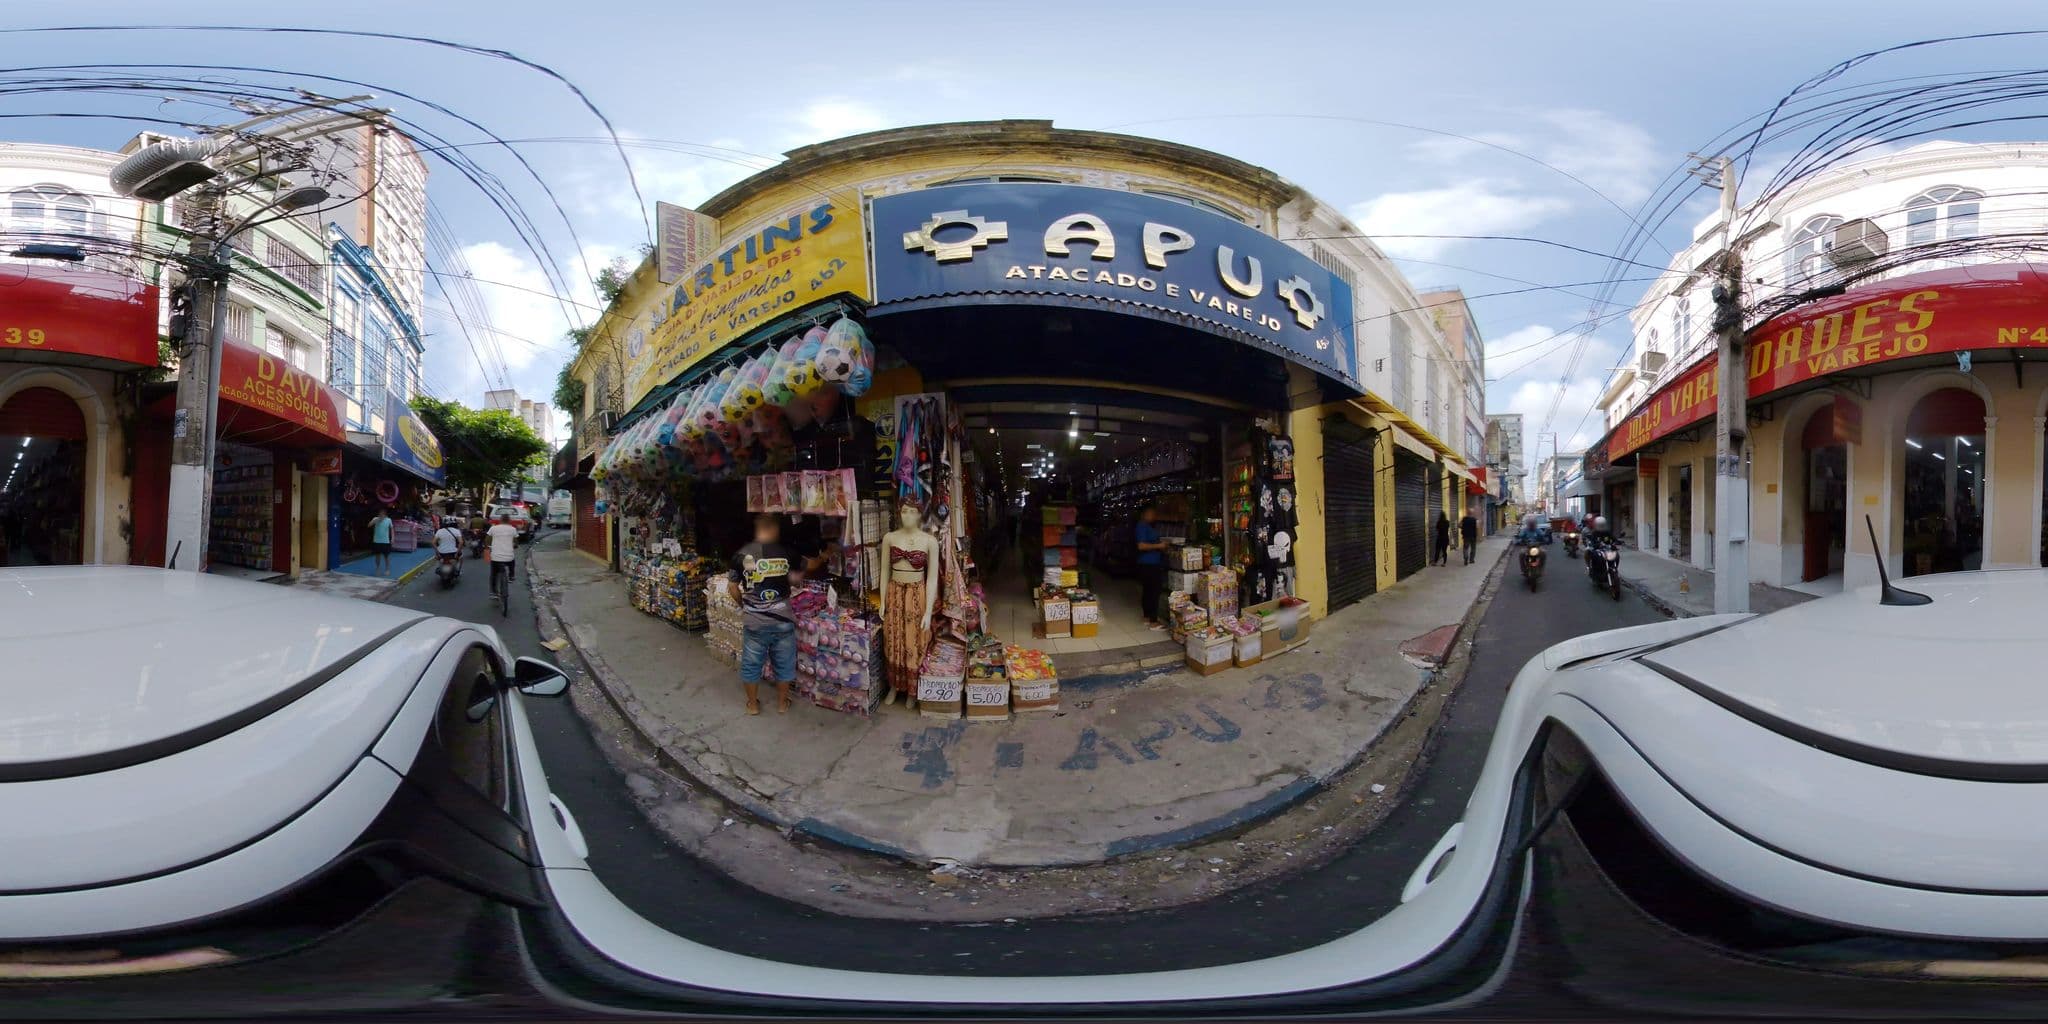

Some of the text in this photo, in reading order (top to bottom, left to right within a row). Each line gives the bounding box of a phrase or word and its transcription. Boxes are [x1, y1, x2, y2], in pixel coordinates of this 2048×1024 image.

[651, 203, 836, 336] MARTINS
[1044, 212, 1264, 298] APU
[709, 329, 718, 342] E
[728, 290, 796, 330] VAREJO
[1005, 265, 1281, 332] ATACADO E VAREJO
[258, 353, 321, 405] DAVI
[1807, 333, 1929, 375] VAREJO
[244, 376, 328, 424] ACESSÓRIOS
[1627, 400, 1662, 444] JOLLY
